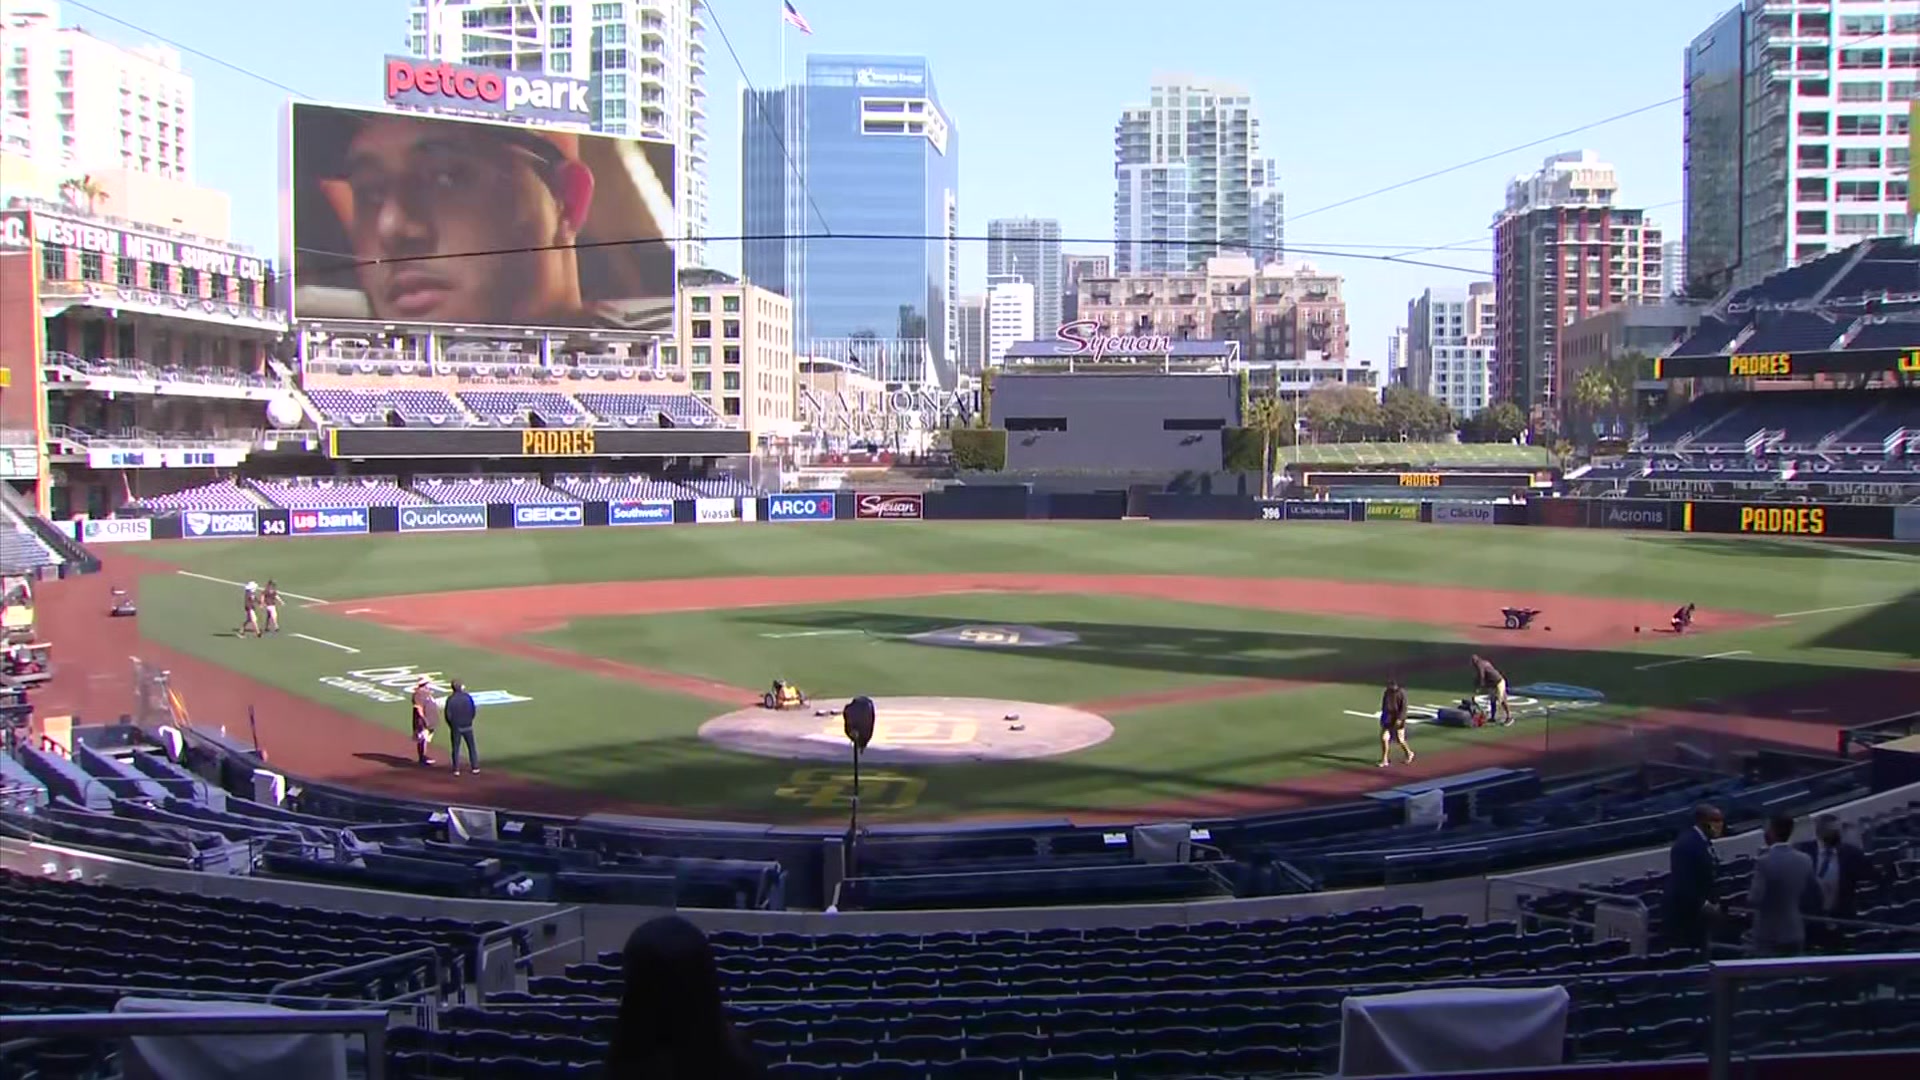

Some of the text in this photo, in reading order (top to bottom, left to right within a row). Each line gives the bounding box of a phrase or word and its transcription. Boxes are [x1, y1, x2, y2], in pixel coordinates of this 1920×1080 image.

[387, 60, 590, 113] petco park
[36, 214, 262, 280] WESTERN METAL SUPPLY CO.
[1054, 320, 1175, 363] Sycuan
[1730, 354, 1792, 376] PADRES
[522, 430, 595, 455] PADRES
[1400, 475, 1440, 486] PADRES
[517, 507, 581, 521] GEICO
[614, 508, 663, 519] Southwest
[771, 500, 817, 515] ARCO
[861, 495, 916, 517] Sycuan
[1262, 507, 1281, 520] 396
[1450, 508, 1490, 520] ClickUp
[402, 510, 484, 526] Qualcomm
[1609, 507, 1663, 523] Acronis
[1741, 507, 1824, 534] PADRES
[106, 520, 148, 535] ORIS
[263, 520, 286, 535] 343
